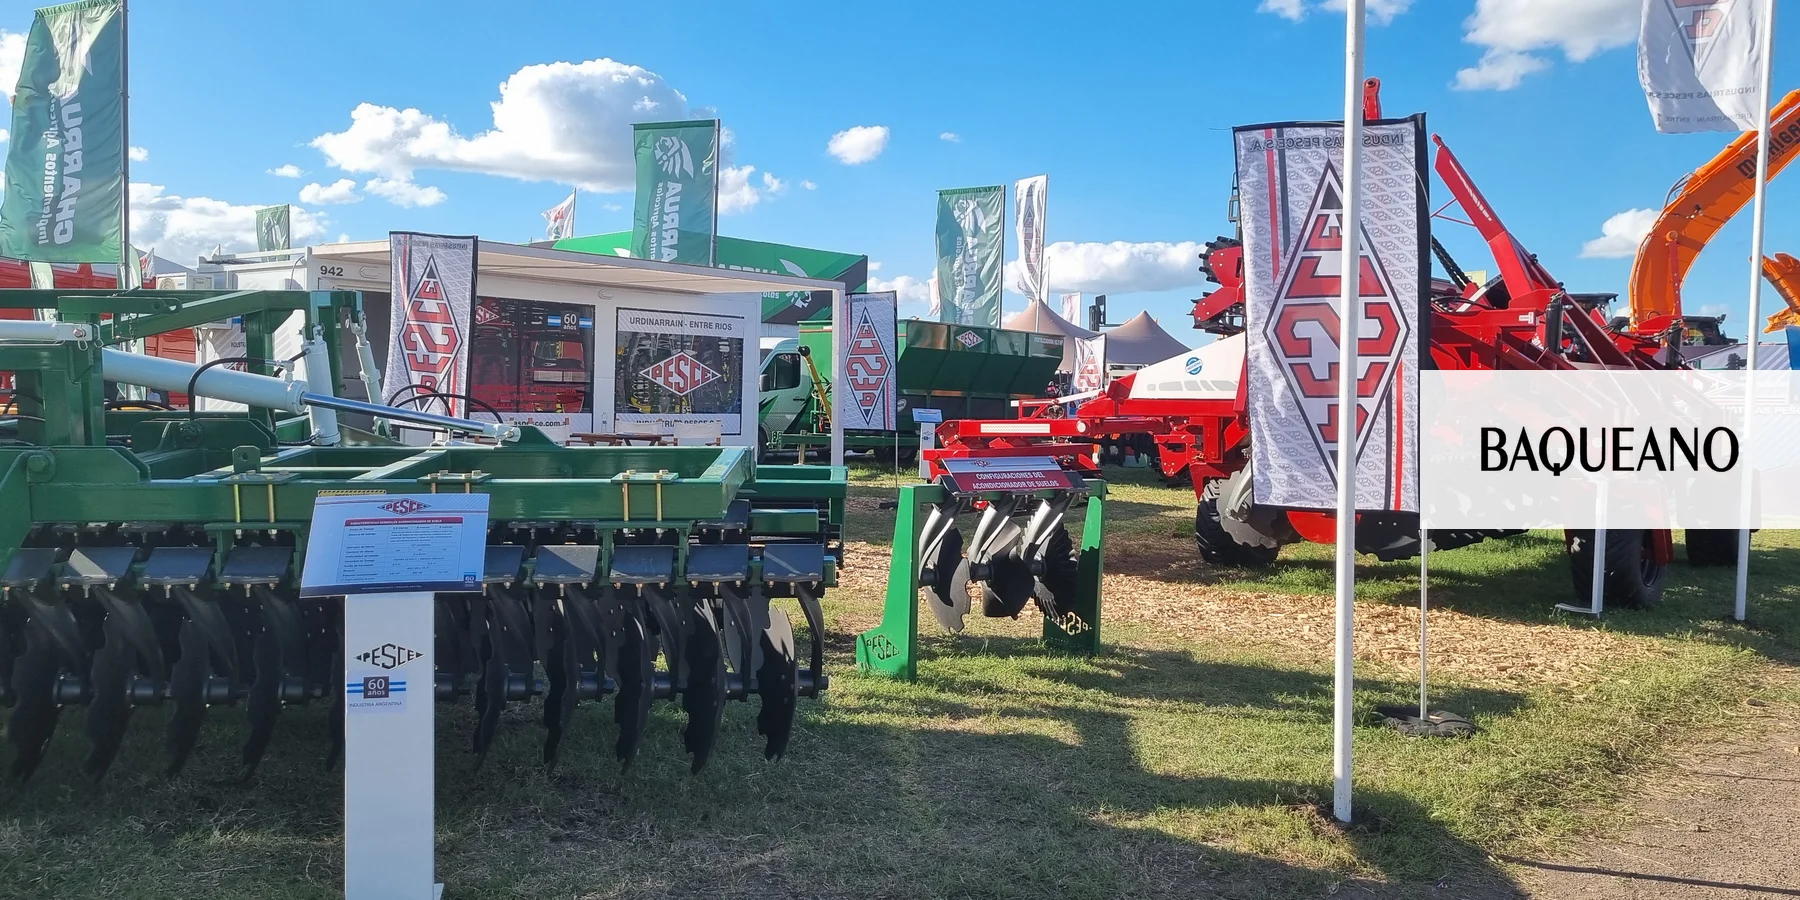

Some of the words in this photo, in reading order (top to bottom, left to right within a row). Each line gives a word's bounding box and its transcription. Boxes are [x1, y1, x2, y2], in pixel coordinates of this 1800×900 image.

[320, 265, 344, 276] 942
[563, 313, 578, 325] 60
[629, 317, 684, 328] URDINARRAIN
[689, 321, 713, 330] ENTRE
[715, 322, 733, 331] RIOS
[650, 354, 712, 394] PESCE
[976, 472, 1032, 480] CONFIGURACIONES
[1033, 471, 1045, 479] DEL
[972, 481, 1026, 490] ACONDICIONADOR
[1037, 480, 1060, 488] SUELOS
[384, 499, 424, 515] PESCE
[362, 643, 415, 669] PESCE
[368, 679, 385, 690] 60
